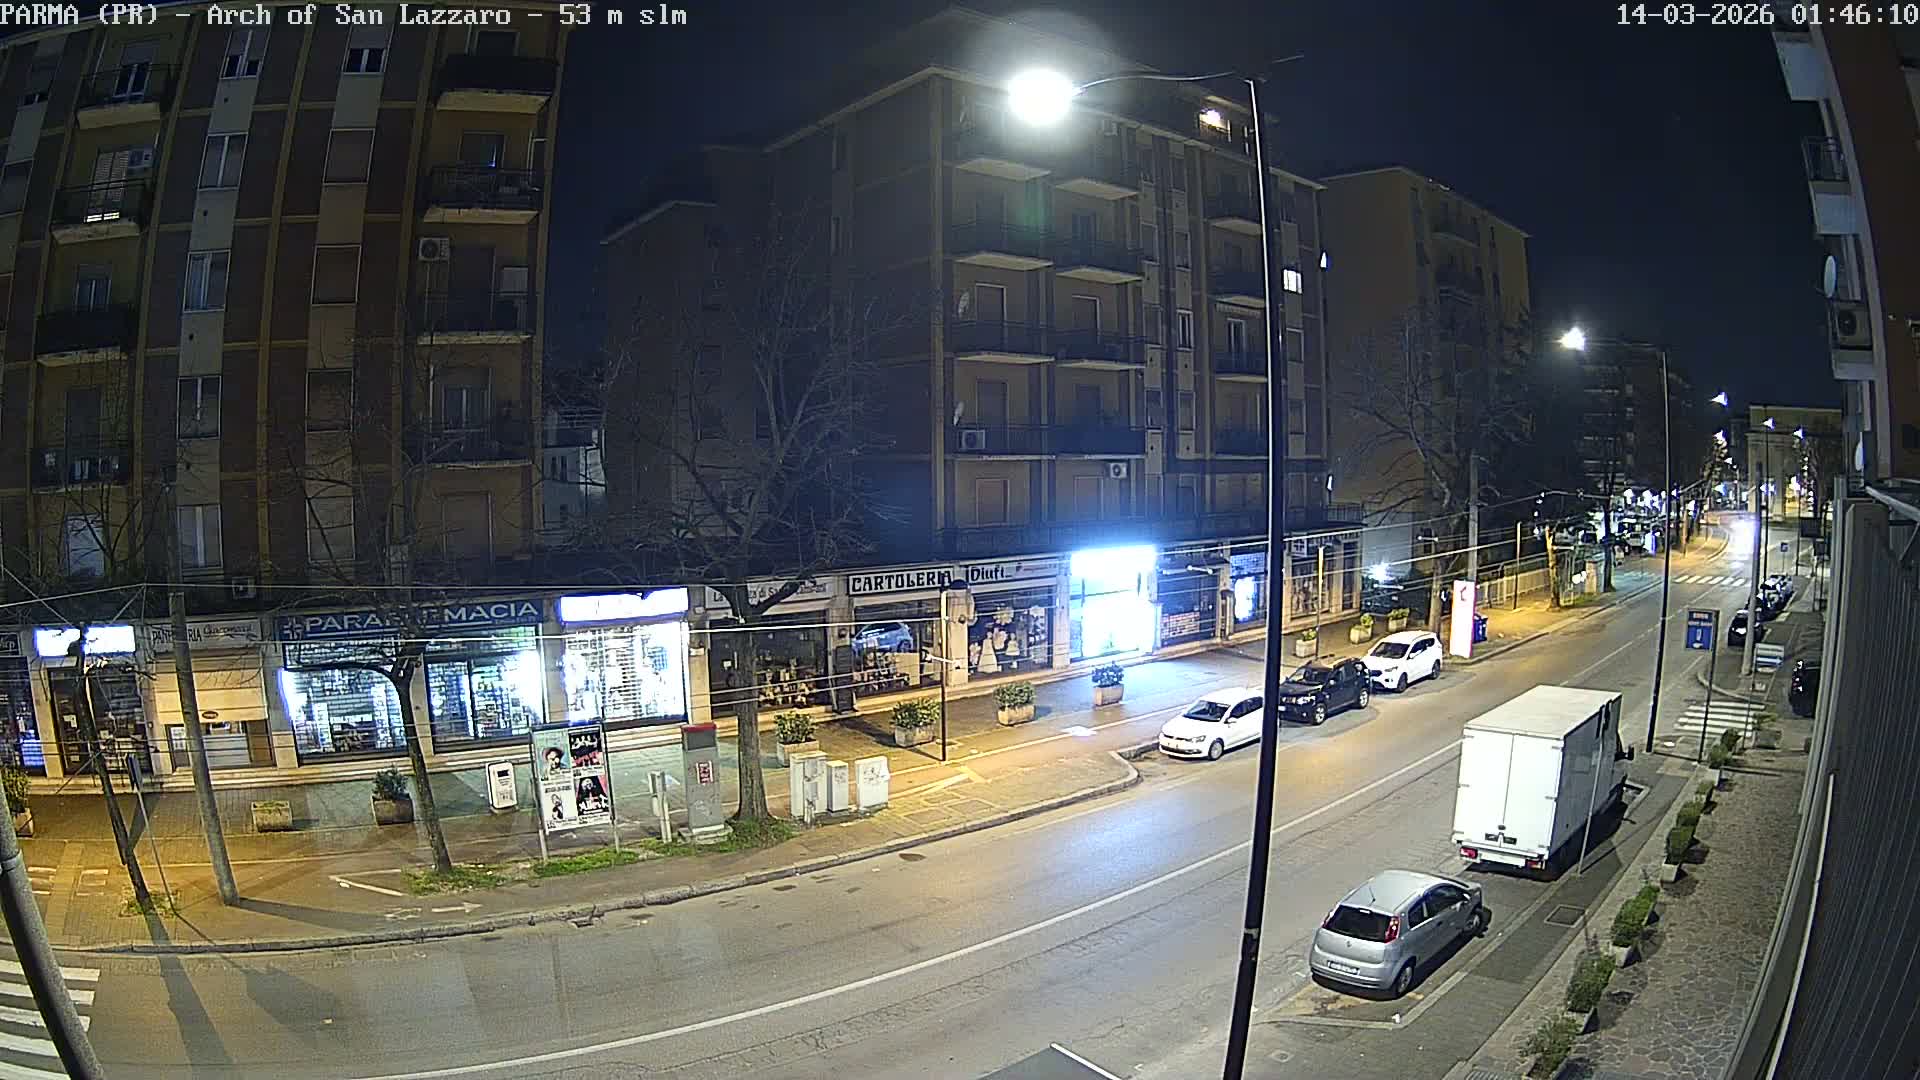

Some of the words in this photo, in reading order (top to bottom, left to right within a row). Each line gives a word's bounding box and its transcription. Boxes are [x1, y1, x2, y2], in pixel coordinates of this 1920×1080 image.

[851, 569, 952, 593] CARTOLERIA
[304, 601, 539, 632] PARAMACIA
[152, 628, 203, 643] PANRIA
